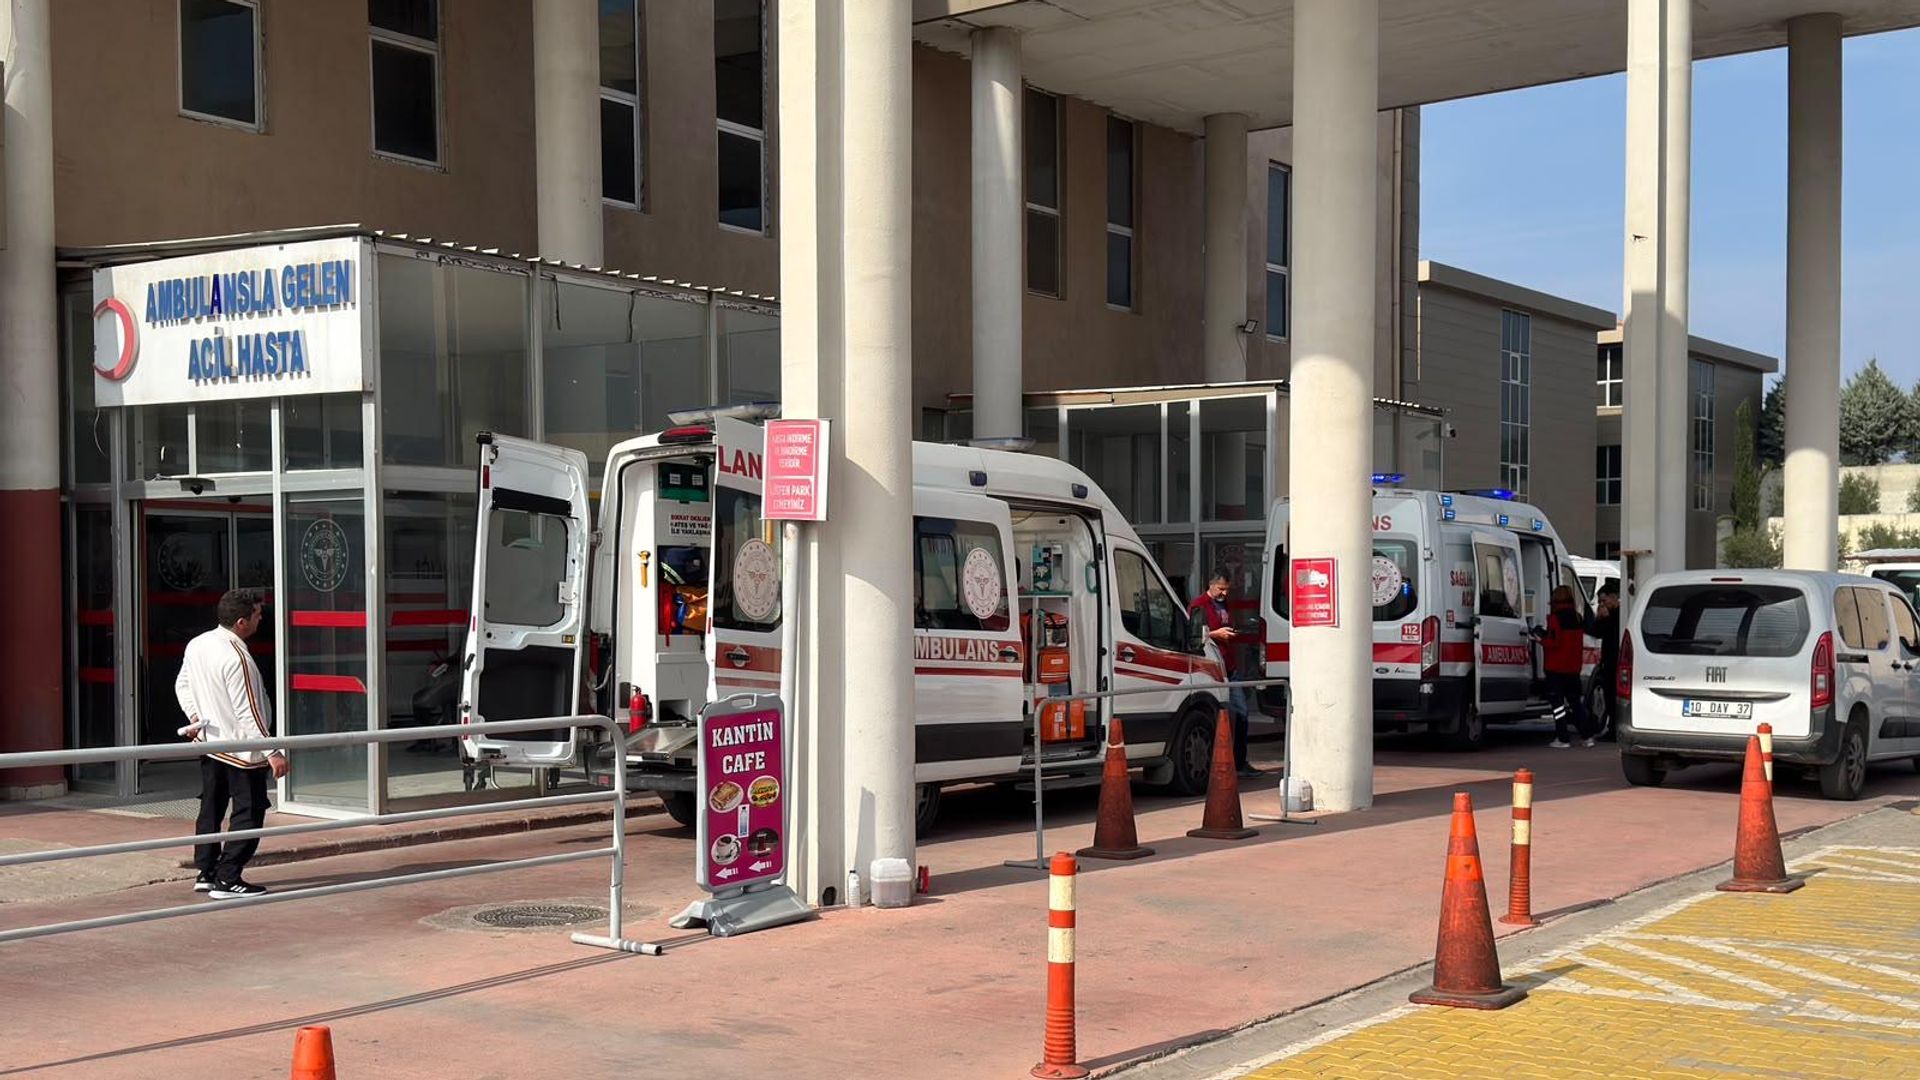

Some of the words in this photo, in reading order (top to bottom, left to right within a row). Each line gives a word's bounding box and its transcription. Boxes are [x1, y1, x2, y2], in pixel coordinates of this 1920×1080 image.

[145, 267, 276, 323] AMBULANSLA
[281, 259, 351, 308] GELEN
[237, 329, 305, 376] HASTA
[791, 484, 811, 496] PARK
[1403, 625, 1418, 635] 112
[1706, 666, 1728, 683] FIAT
[1691, 702, 1702, 712] 10
[1737, 703, 1750, 714] 37
[712, 718, 774, 748] KANTİN
[722, 751, 766, 774] CAFE
